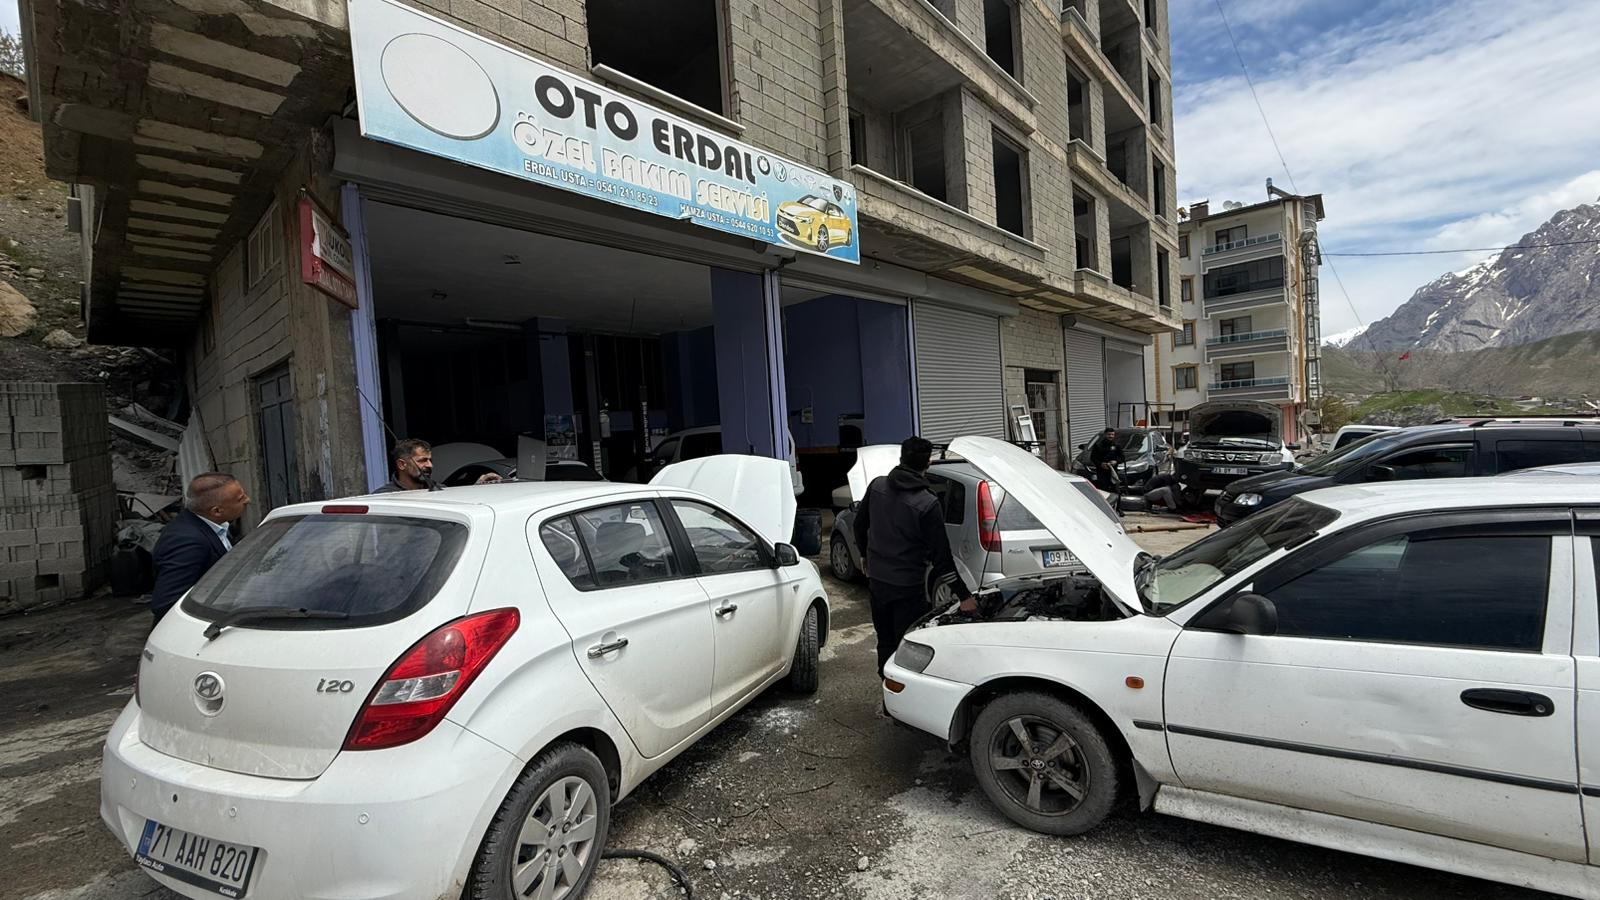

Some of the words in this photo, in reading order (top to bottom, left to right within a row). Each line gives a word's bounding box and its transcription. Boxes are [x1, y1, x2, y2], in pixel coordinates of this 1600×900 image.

[534, 74, 639, 142] OTO
[651, 117, 757, 185] ERDAL
[511, 110, 597, 174] ÖZEL
[602, 147, 692, 201] BAKIM
[523, 159, 559, 180] ERDAL
[560, 169, 587, 188] USTA
[596, 180, 618, 195] 0541
[619, 186, 635, 201] 211
[648, 194, 659, 207] 23
[680, 203, 705, 219] HAMZA
[708, 211, 724, 224] USTA
[731, 219, 747, 230] 0544
[1049, 550, 1061, 563] 09
[316, 678, 355, 693] i20
[151, 824, 173, 858] 71
[174, 832, 210, 872] AAH
[210, 843, 248, 883] 820
